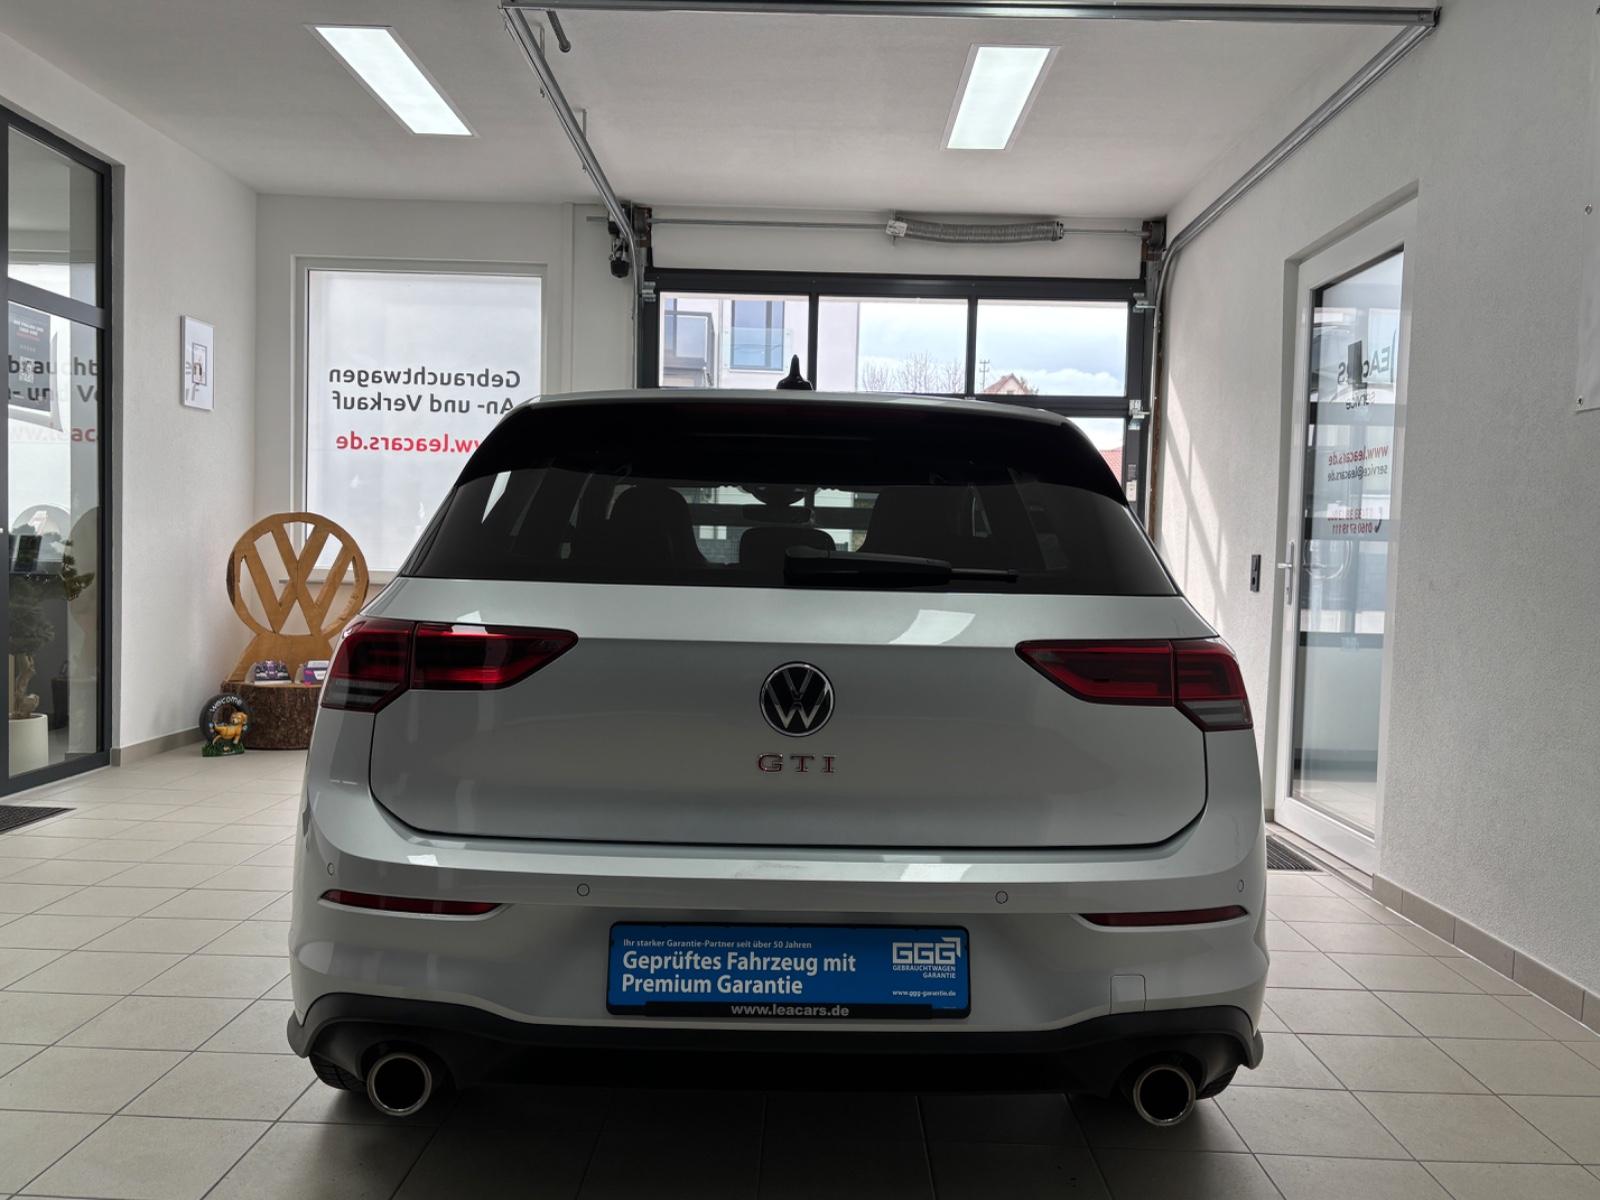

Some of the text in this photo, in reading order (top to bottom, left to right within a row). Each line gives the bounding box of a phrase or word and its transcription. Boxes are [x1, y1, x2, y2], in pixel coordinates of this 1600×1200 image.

[757, 753, 836, 773] GTI
[623, 938, 812, 950] Ihr starker Garantie-Partner seit über 50 Jahren
[623, 950, 856, 976] Geprüftes Fahrzeug mit
[892, 964, 956, 972] GEBRAUCHTWAGEN
[621, 973, 803, 995] Premium Garantie
[892, 989, 957, 998] www.ggg-garantie.de
[731, 1003, 850, 1018] www.leacars.de
